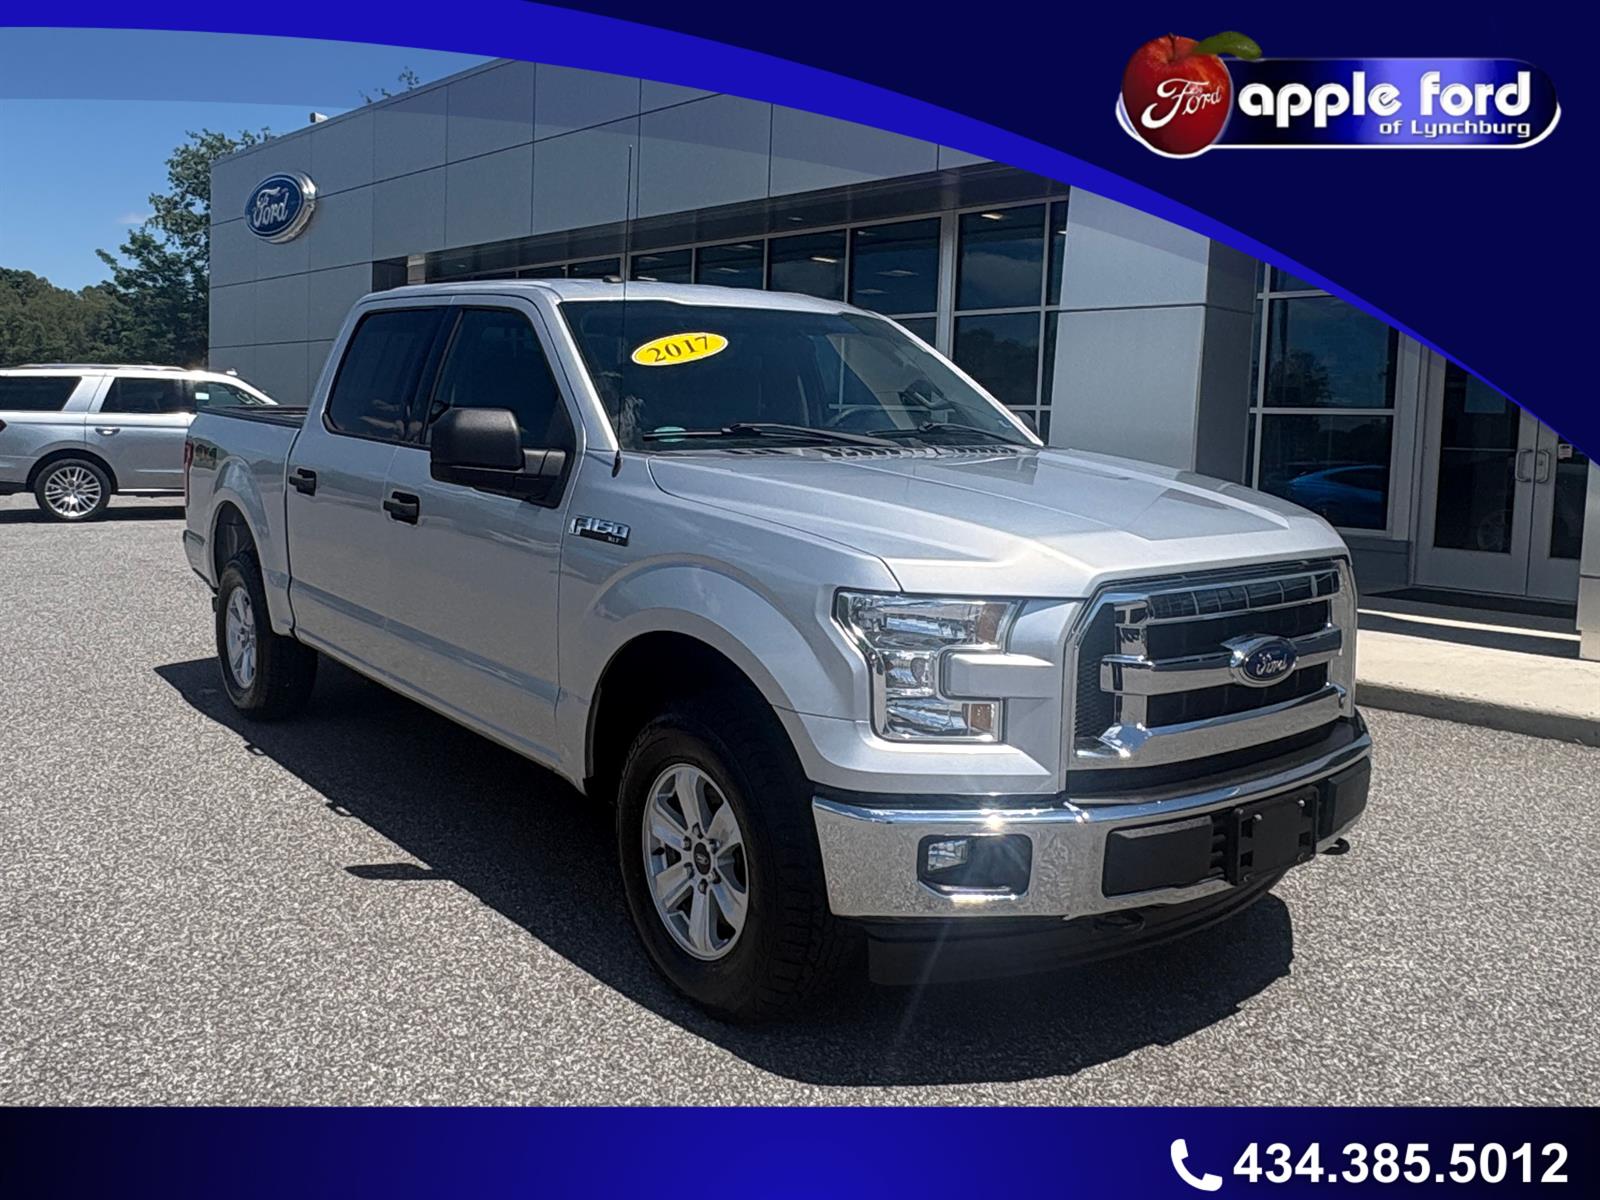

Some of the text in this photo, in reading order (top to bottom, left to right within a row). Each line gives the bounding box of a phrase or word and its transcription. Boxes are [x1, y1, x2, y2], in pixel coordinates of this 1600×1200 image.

[252, 186, 290, 228] Ford
[646, 336, 708, 362] 2017
[1255, 652, 1289, 676] Ford
